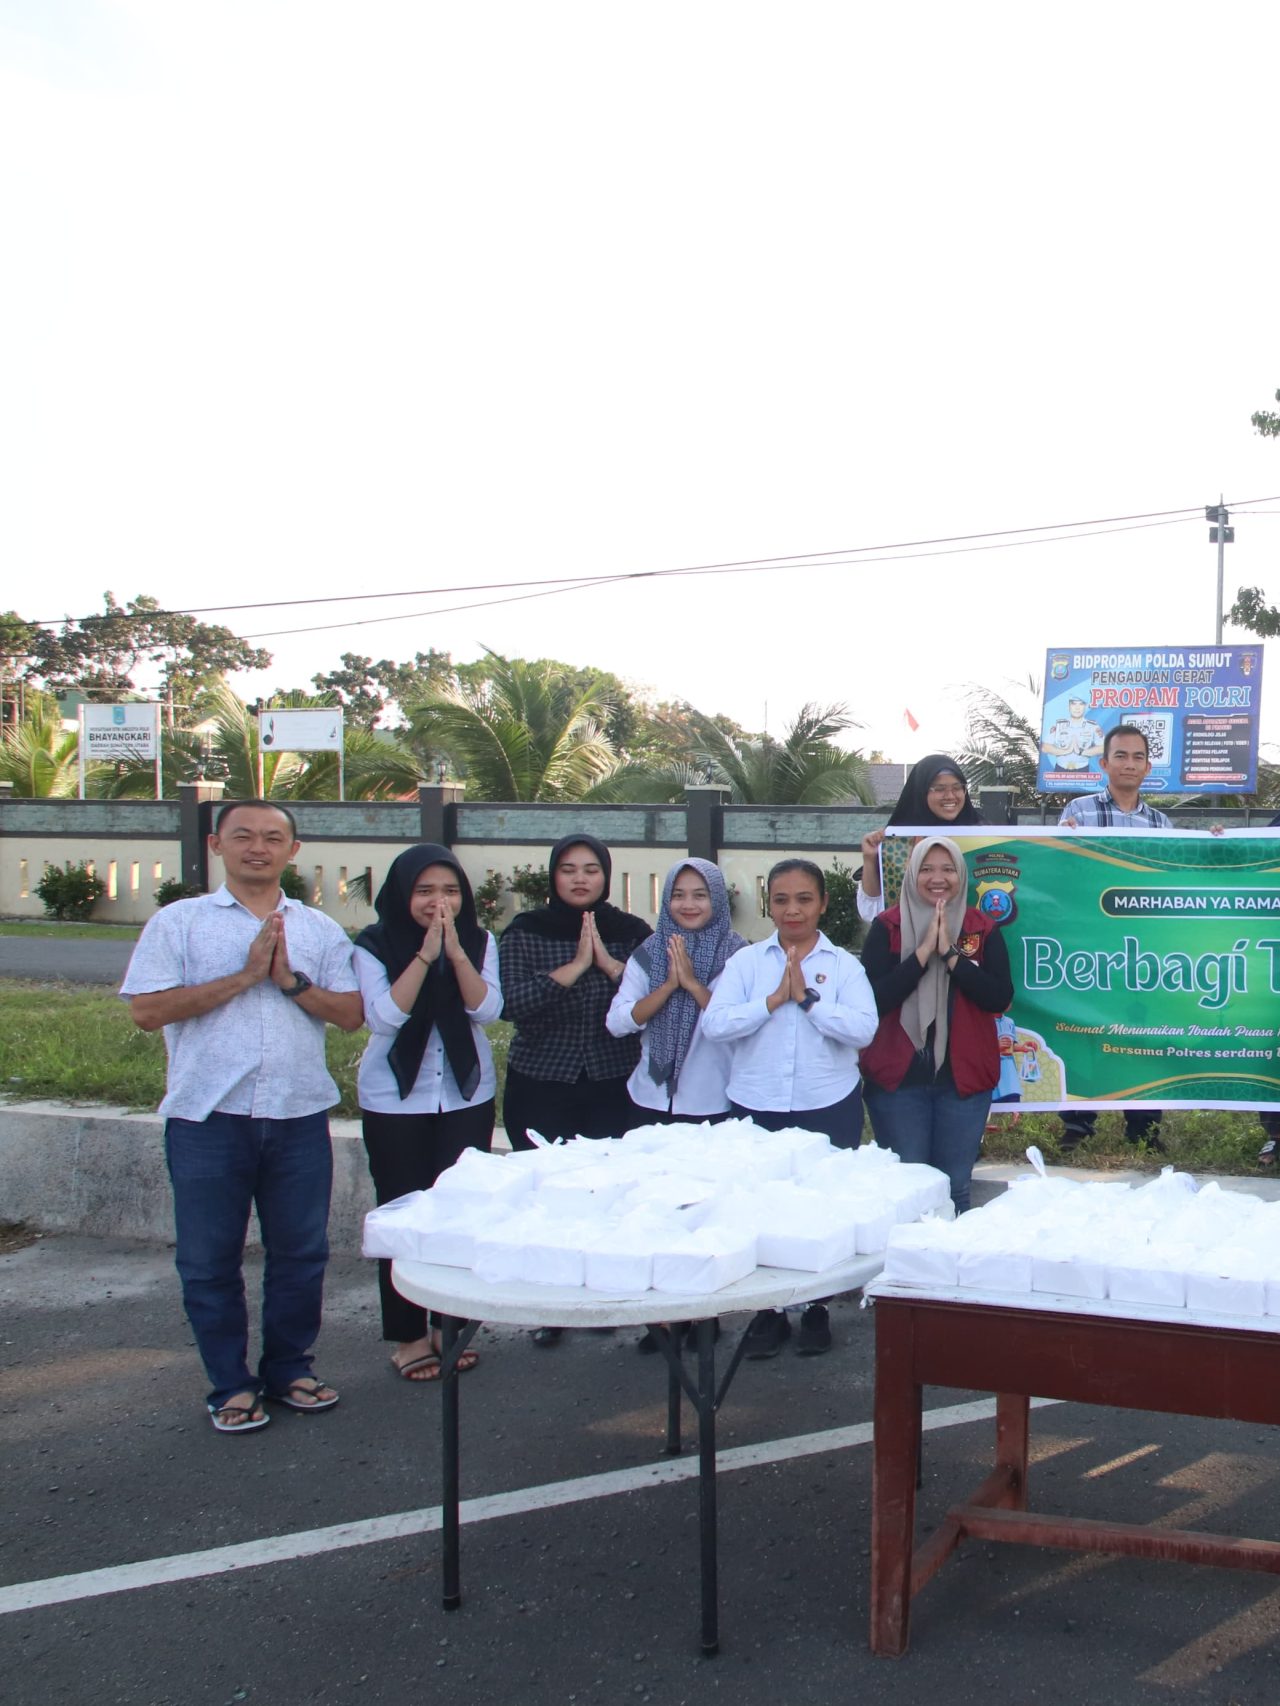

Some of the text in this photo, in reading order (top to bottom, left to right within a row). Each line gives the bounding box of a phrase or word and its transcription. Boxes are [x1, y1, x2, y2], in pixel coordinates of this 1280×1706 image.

[1073, 652, 1232, 670] BIDPROPAM POLDA SUMUT
[1091, 669, 1214, 685] PENGADUAN CEPAT
[1089, 686, 1252, 708] PROPAM POLRI
[89, 732, 151, 741] BHAYANGKARI
[1114, 896, 1207, 910] MARHABAN
[1210, 896, 1231, 910] YA
[1021, 936, 1250, 1010] Berbagi
[1055, 1022, 1105, 1035] Selamat
[1107, 1023, 1185, 1036] Menunaikan
[1187, 1024, 1232, 1037] Ibadah
[1234, 1024, 1274, 1037] Puasa
[1102, 1043, 1164, 1057] Bersama
[1166, 1046, 1212, 1059] Polres
[1214, 1047, 1273, 1060] serdang
